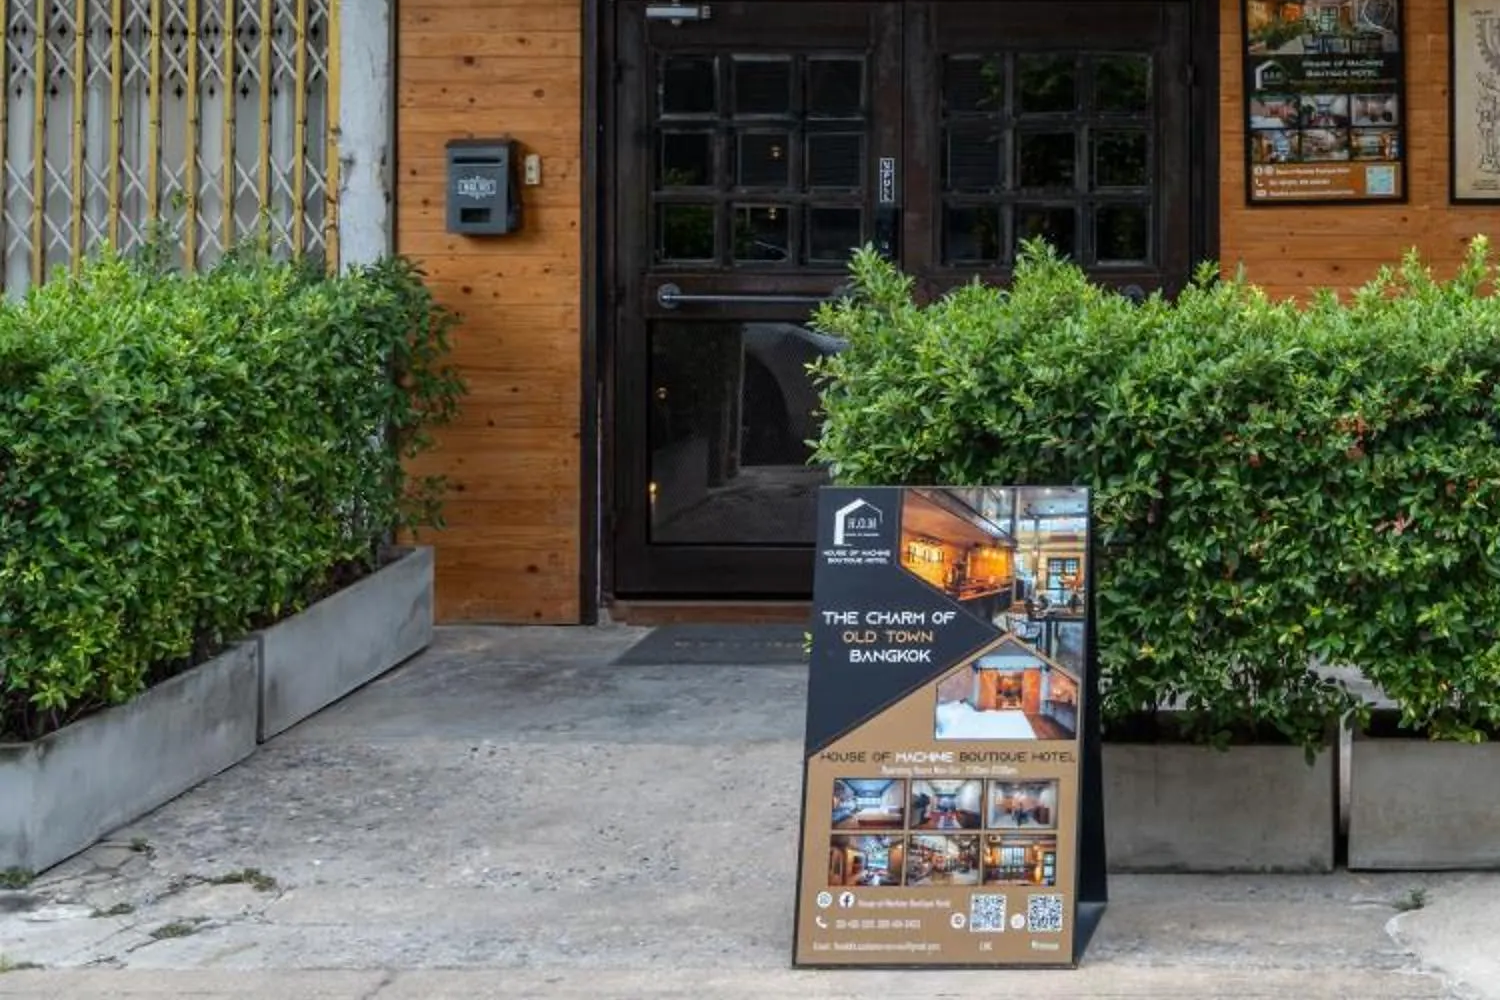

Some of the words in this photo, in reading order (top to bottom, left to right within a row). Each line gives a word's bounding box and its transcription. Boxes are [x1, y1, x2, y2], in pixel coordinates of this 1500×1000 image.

[822, 611, 859, 625] THE
[865, 611, 925, 625] CHARM
[931, 611, 956, 625] OF
[843, 630, 877, 643] OLD
[885, 630, 934, 643] TOWN
[849, 649, 932, 663] BANGKOK
[820, 751, 866, 762] HOUSE
[872, 751, 892, 762] OF
[895, 751, 954, 763] MACHINE
[959, 751, 1027, 763] BOUTIQUE
[1031, 751, 1076, 763] HOTEL
